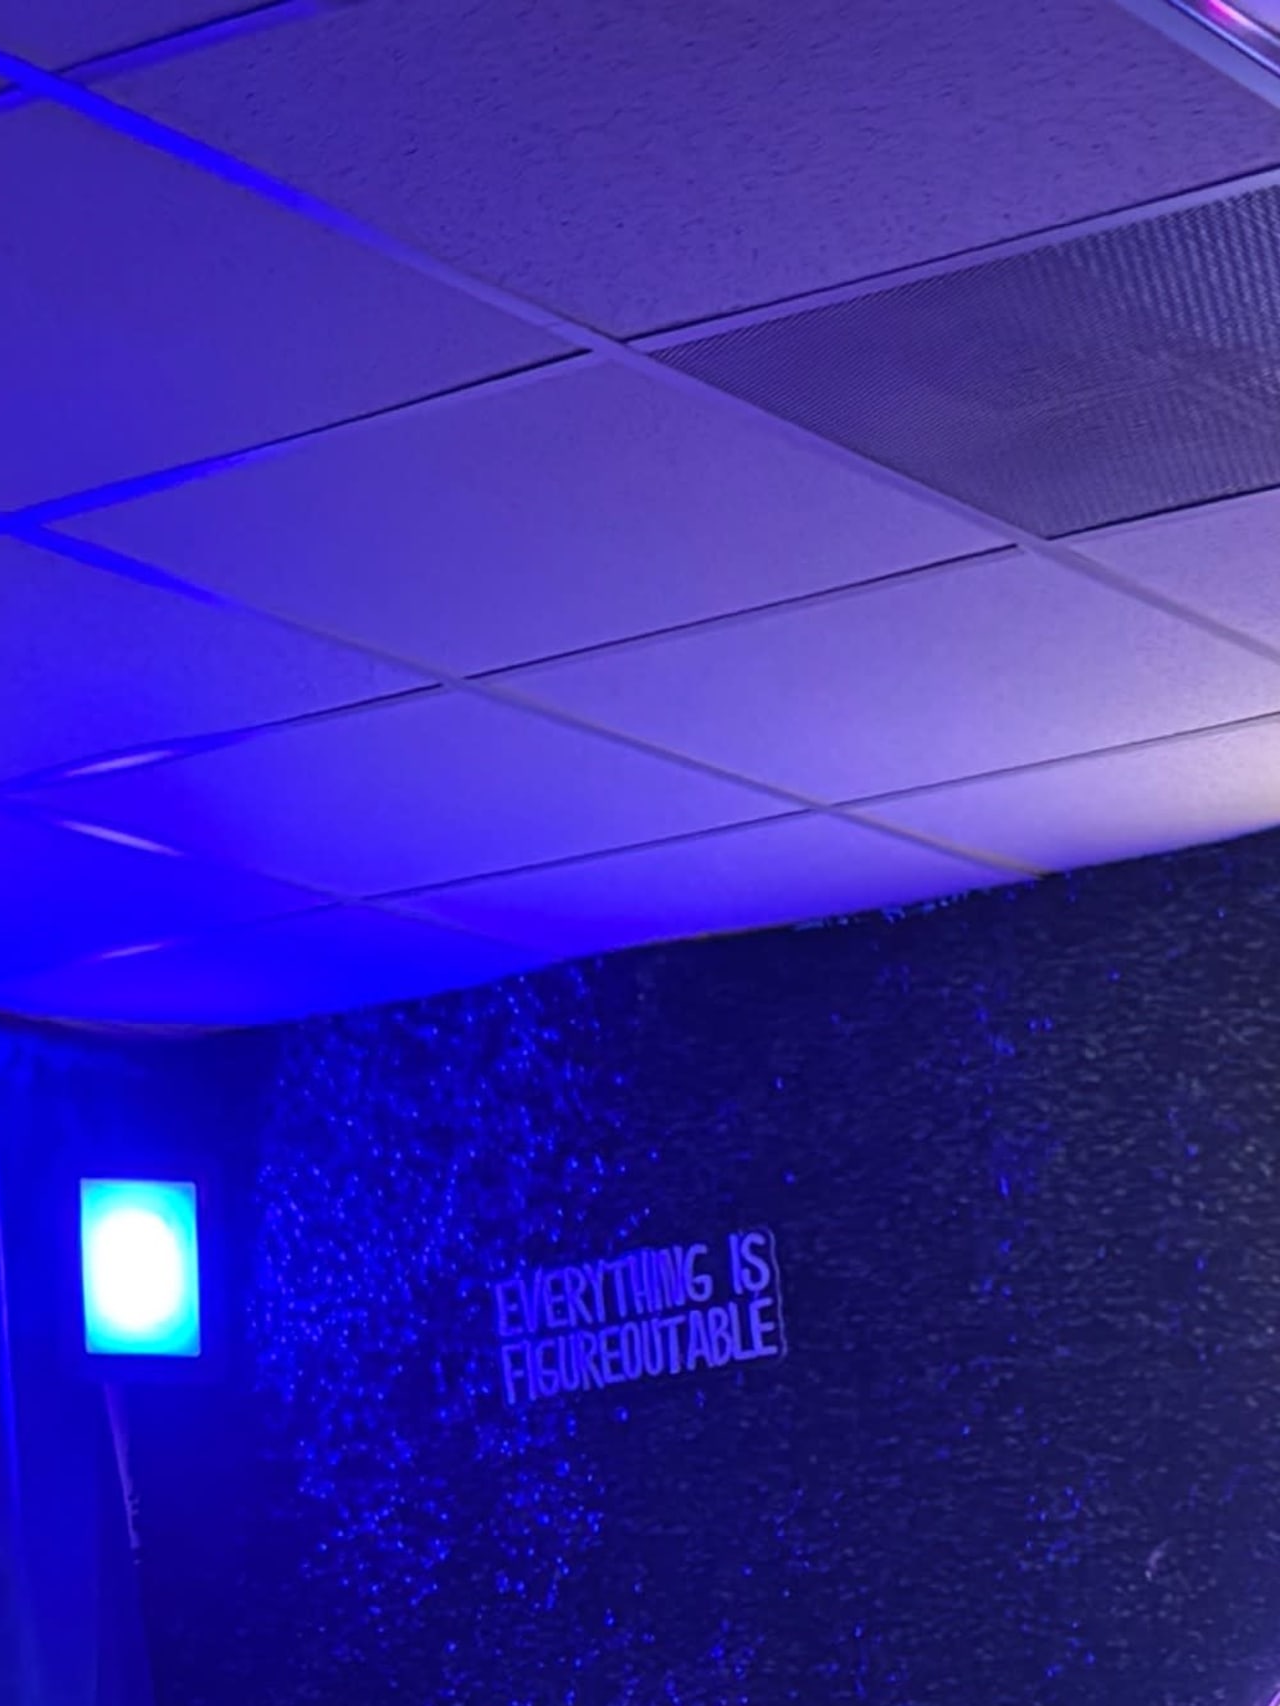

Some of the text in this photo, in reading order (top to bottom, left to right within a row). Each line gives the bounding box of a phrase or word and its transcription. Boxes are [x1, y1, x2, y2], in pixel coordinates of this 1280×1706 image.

[493, 1231, 772, 1337] EVERYTHING IS
[500, 1297, 779, 1404] FIGUREOUTABLE
